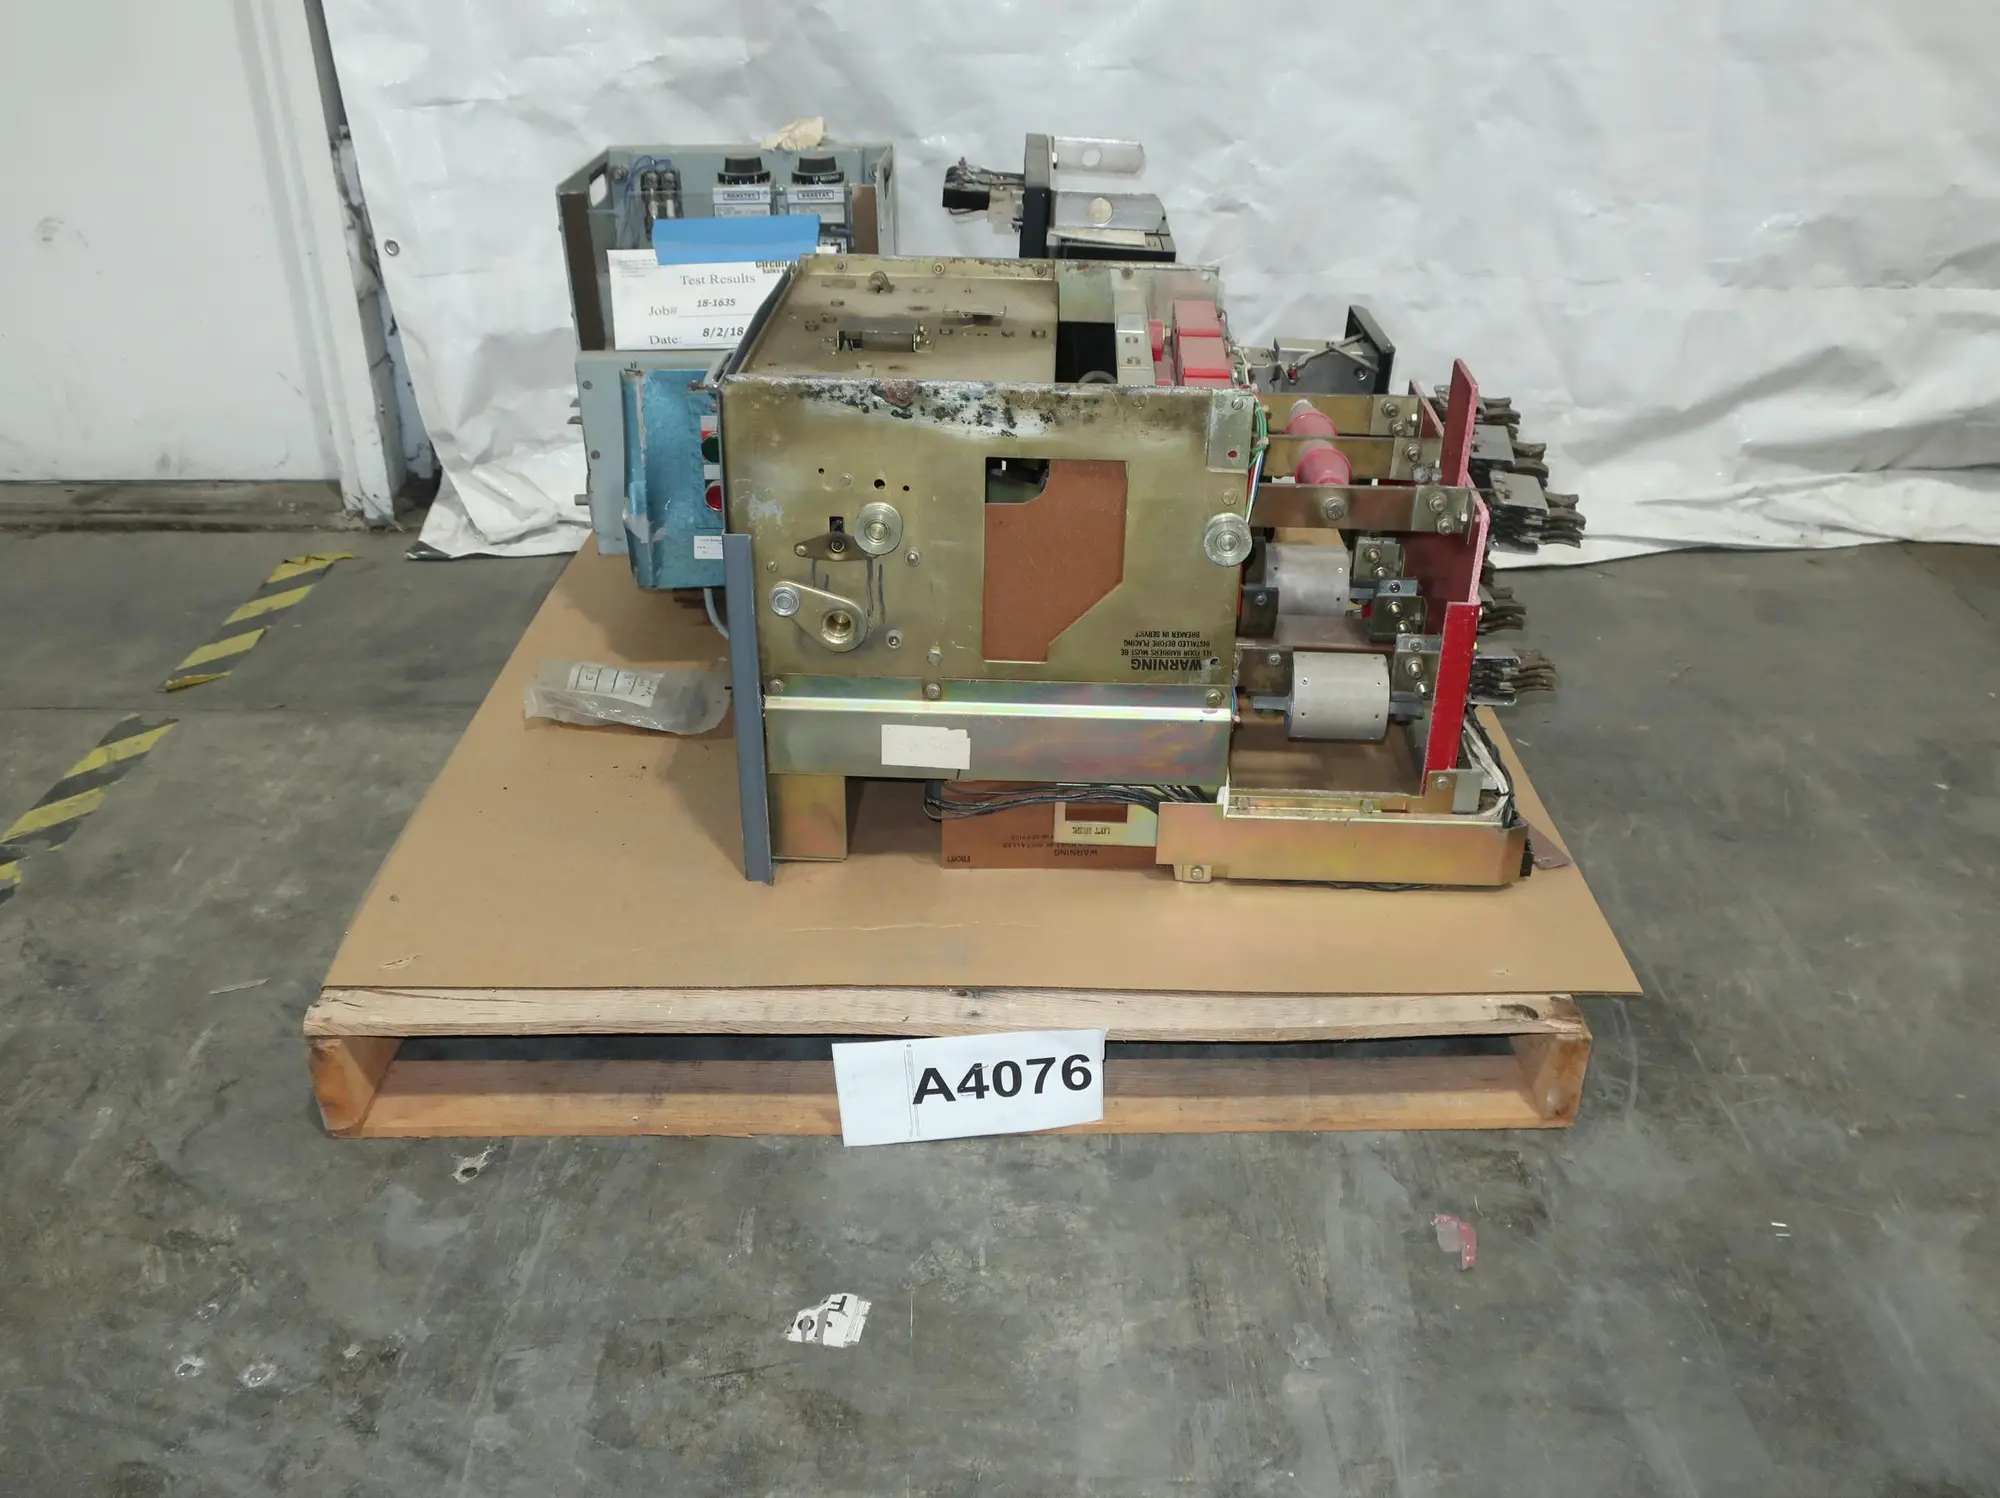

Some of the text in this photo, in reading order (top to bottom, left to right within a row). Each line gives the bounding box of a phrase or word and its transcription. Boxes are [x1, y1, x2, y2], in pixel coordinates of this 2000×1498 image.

[680, 274, 756, 285] Test Results
[648, 298, 736, 317] Job# 18-1635
[649, 327, 744, 346] Date: 8/2/18
[1124, 639, 1150, 647] PLACING
[1131, 659, 1202, 671] WARNING
[913, 1054, 1092, 1104] A4076
